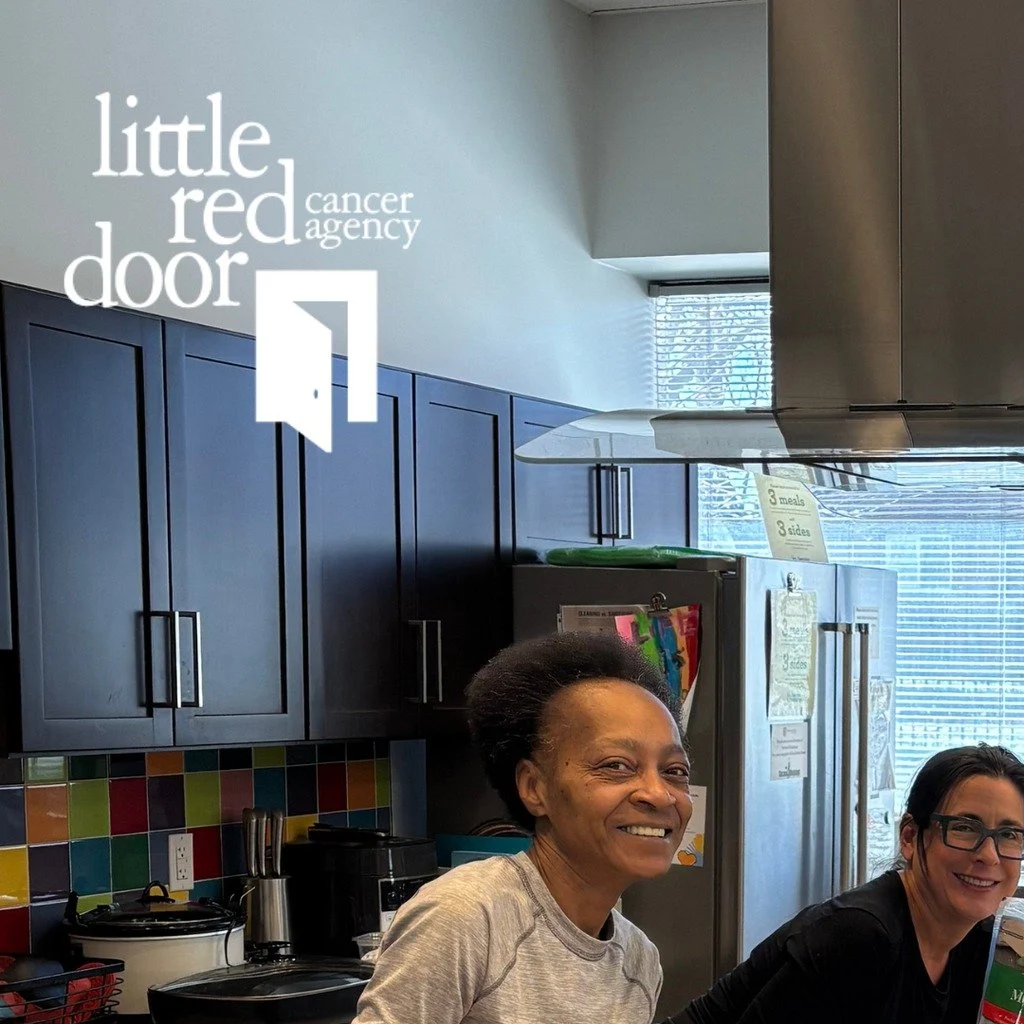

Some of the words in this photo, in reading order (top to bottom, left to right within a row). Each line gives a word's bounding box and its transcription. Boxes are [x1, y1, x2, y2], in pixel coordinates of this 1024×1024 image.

[768, 488, 777, 506] 3
[779, 494, 806, 506] meals
[776, 520, 786, 537] 3
[788, 524, 811, 537] sides
